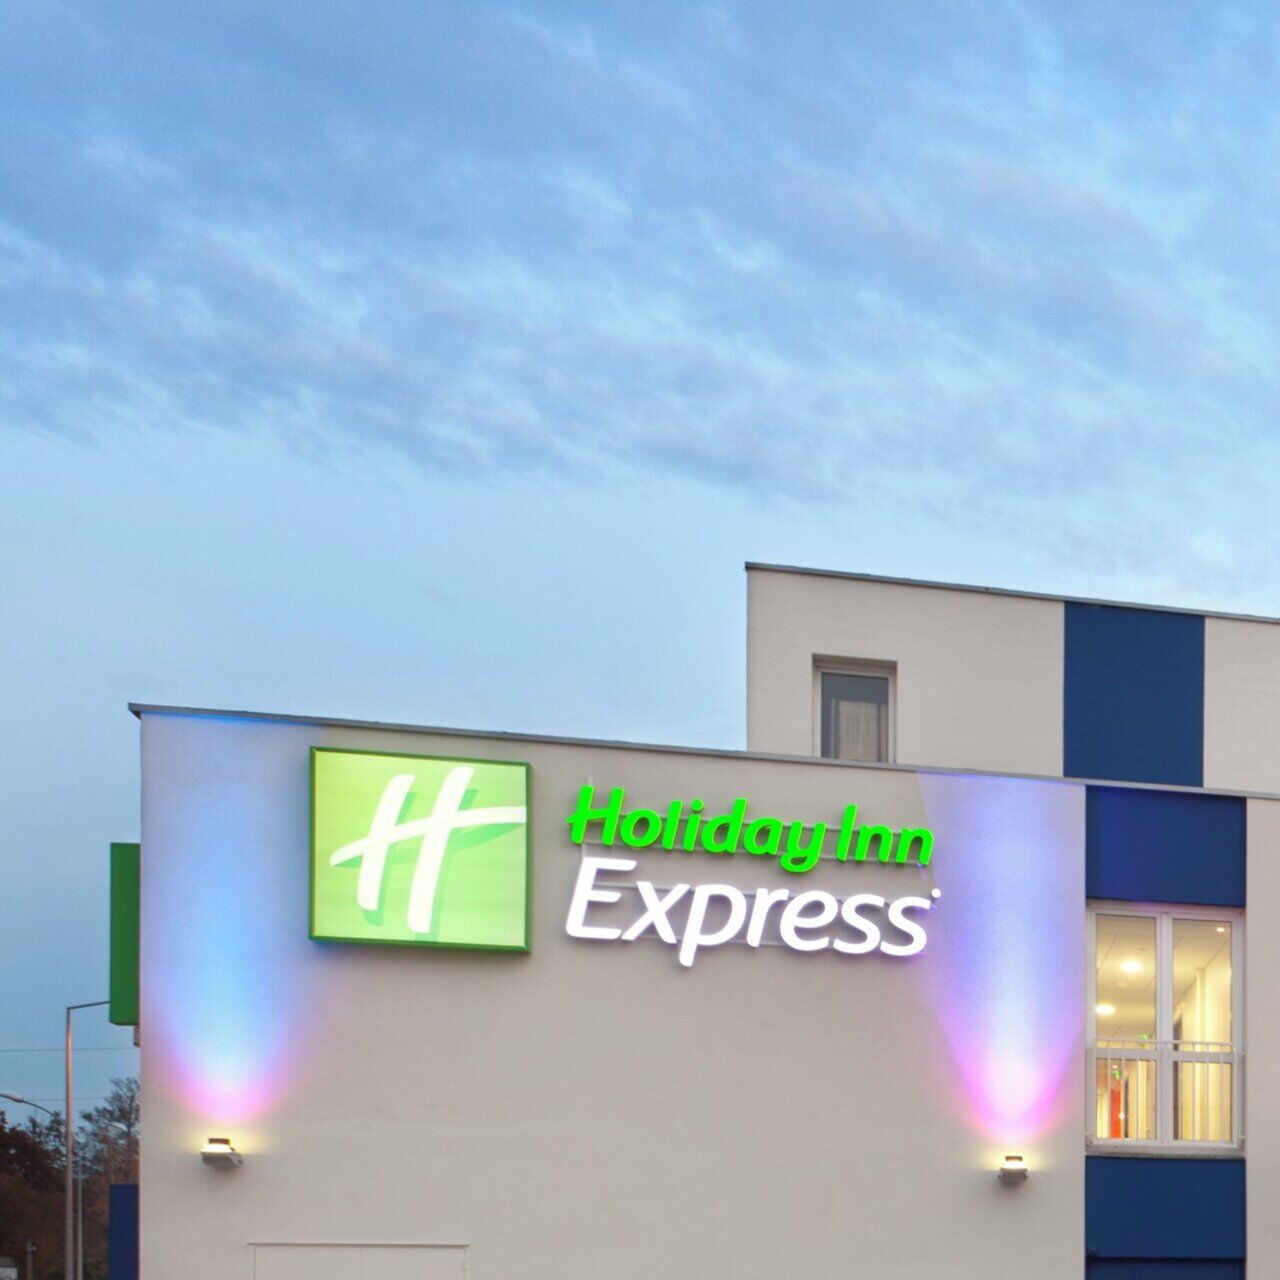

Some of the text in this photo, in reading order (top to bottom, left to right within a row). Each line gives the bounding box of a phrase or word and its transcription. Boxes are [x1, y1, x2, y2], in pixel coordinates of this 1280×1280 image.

[566, 784, 935, 873] Holiday Inn
[564, 856, 934, 967] Express
